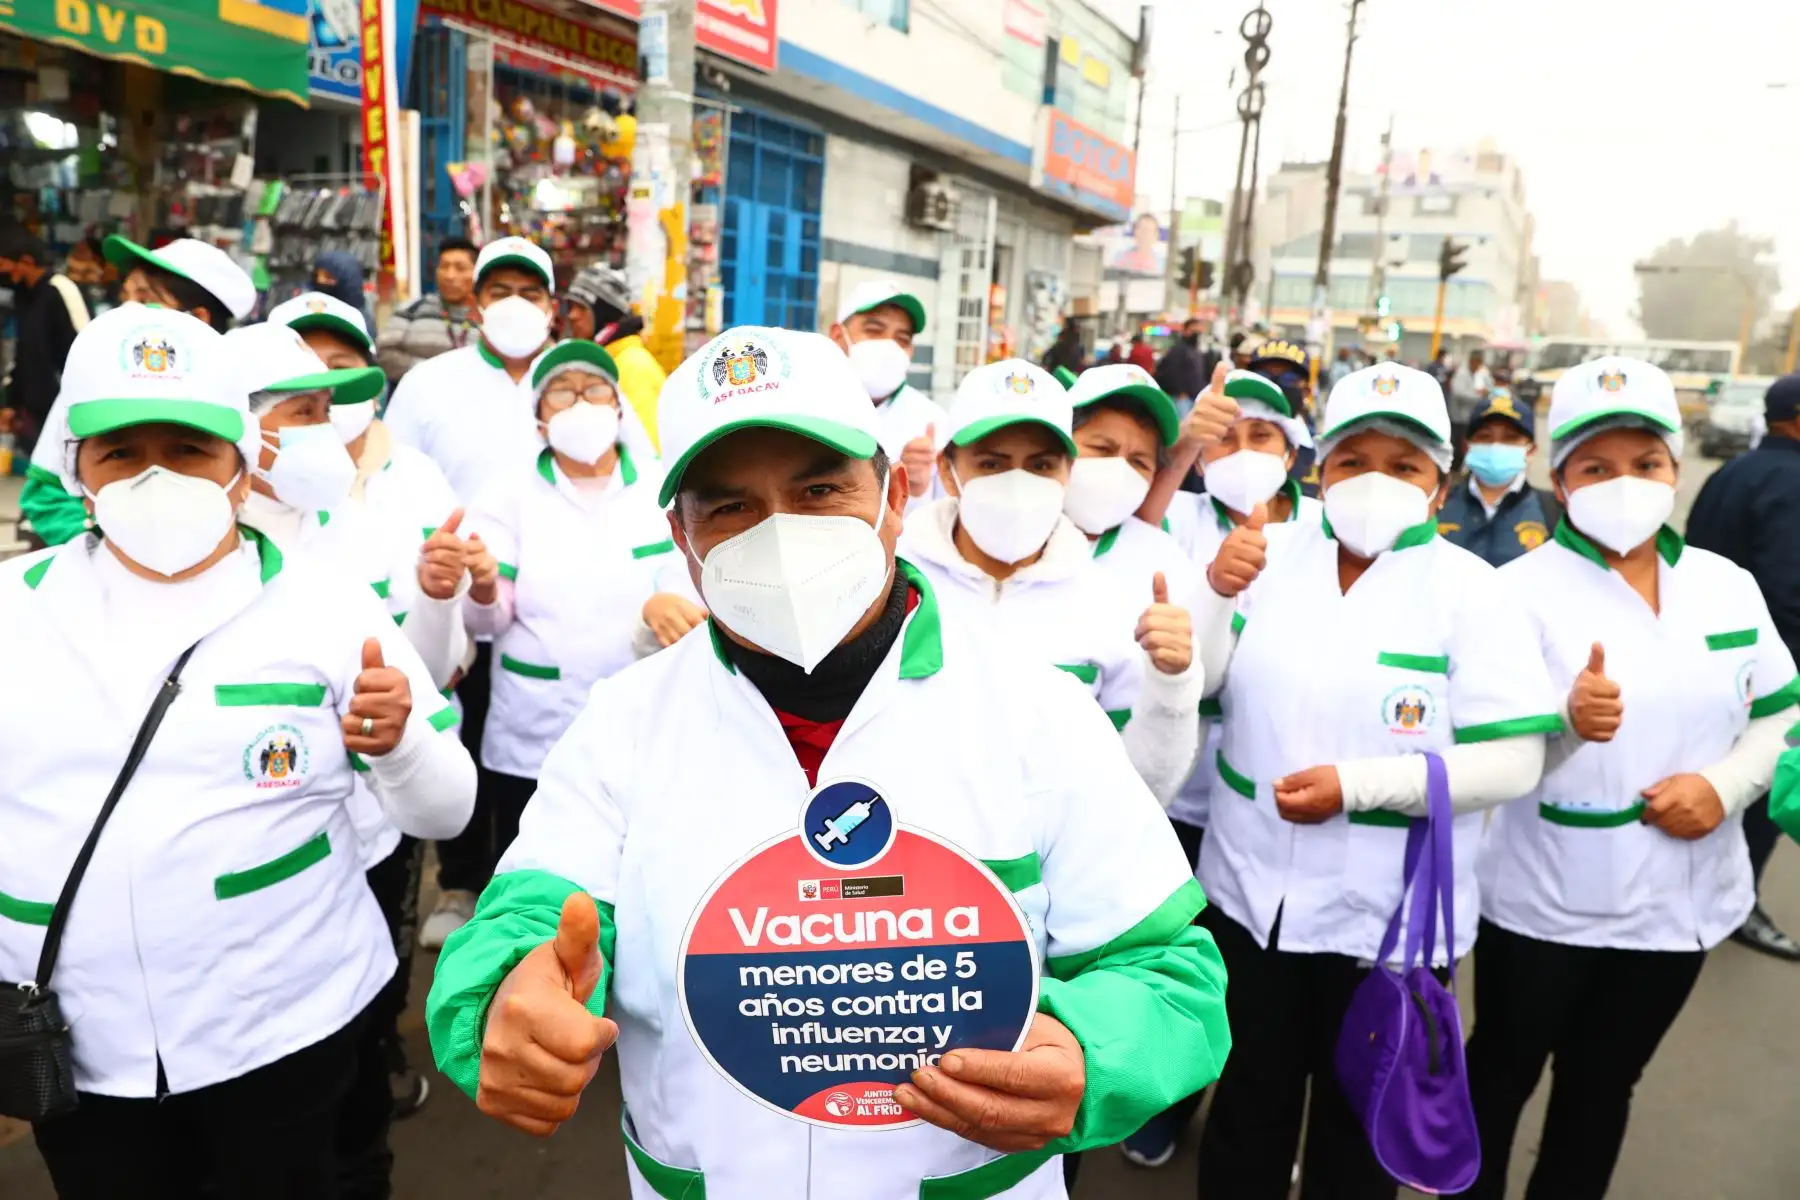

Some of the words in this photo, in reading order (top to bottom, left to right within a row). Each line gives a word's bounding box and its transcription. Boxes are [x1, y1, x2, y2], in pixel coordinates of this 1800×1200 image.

[56, 0, 168, 55] DVD
[1053, 119, 1130, 182] BOTICA
[822, 885, 839, 893] PERÚ
[728, 907, 934, 947] Vacuna
[944, 906, 980, 938] a
[739, 962, 894, 986] menores
[901, 954, 947, 981] de
[955, 951, 977, 979] 5
[739, 992, 825, 1017] años
[831, 990, 945, 1016] contra
[952, 985, 983, 1012] la
[772, 1022, 926, 1045] influenza
[932, 1025, 954, 1049] y
[855, 1097, 897, 1105] VENCEREM
[863, 1089, 893, 1098] JUNTOS
[856, 1105, 872, 1116] AL
